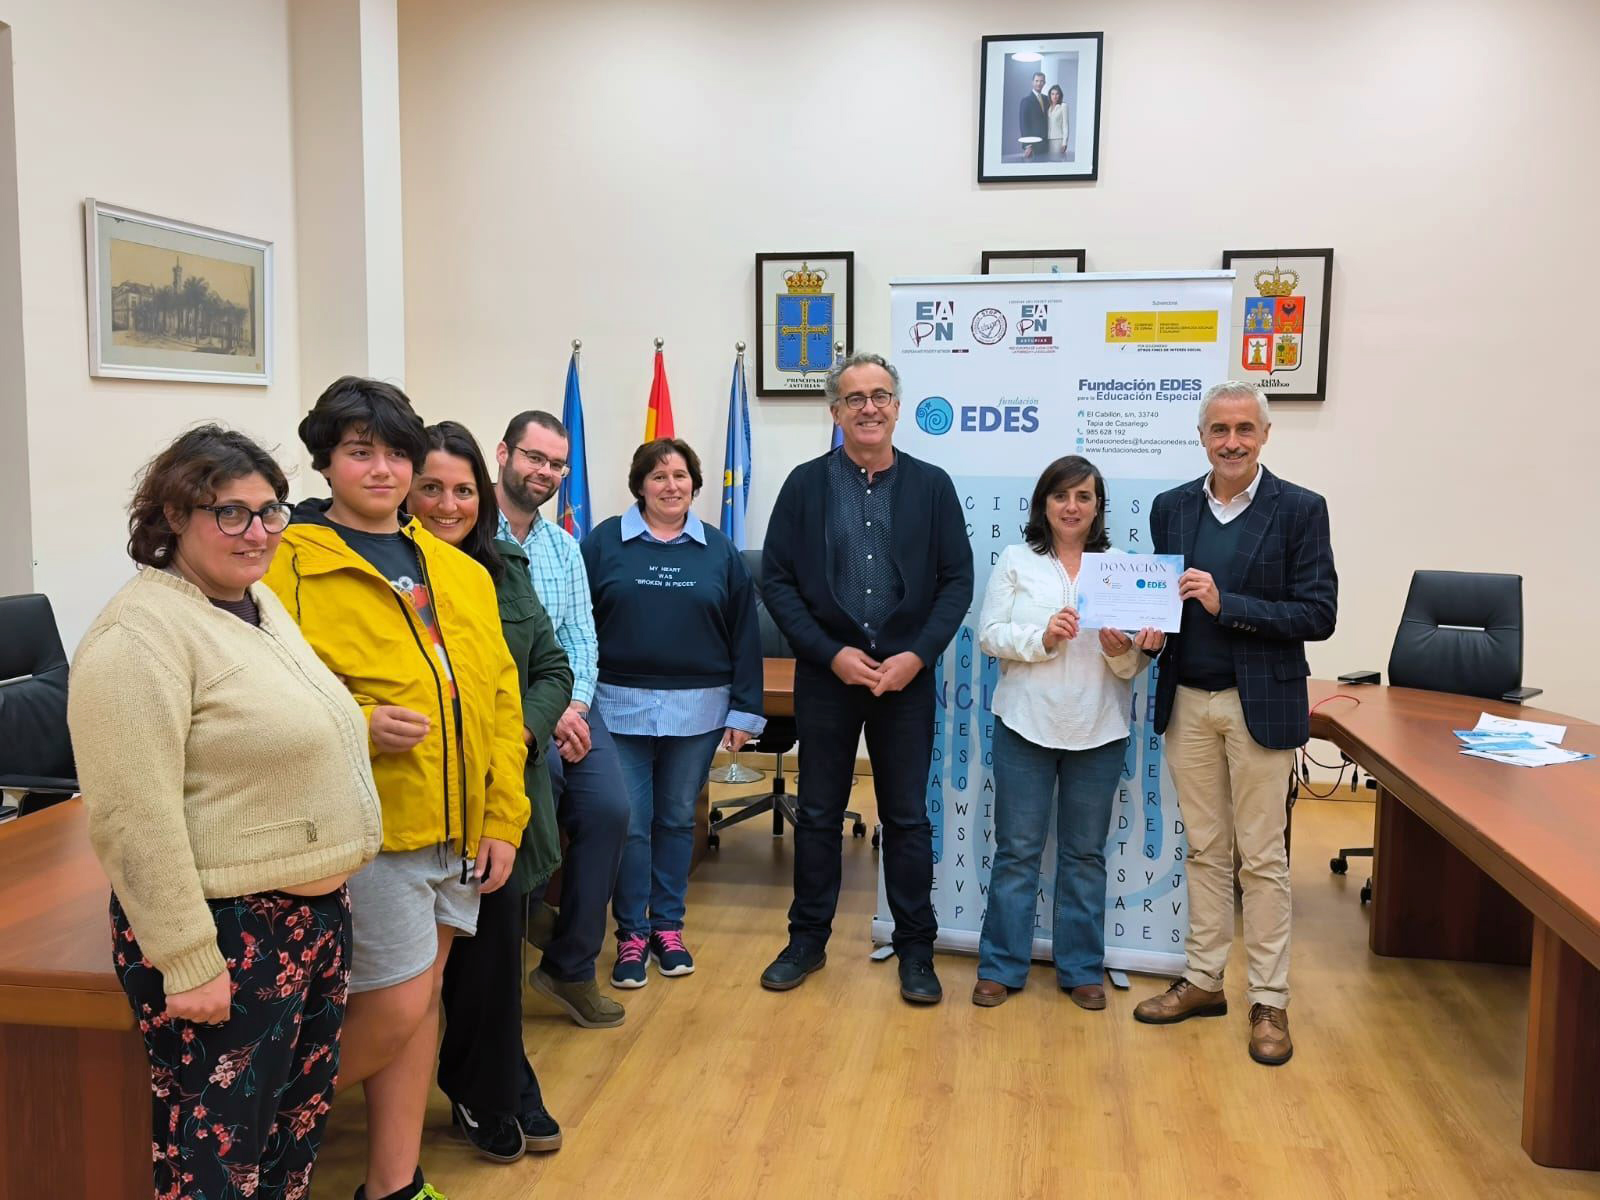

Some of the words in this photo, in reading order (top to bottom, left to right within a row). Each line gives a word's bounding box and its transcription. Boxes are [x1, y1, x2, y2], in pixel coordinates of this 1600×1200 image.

[1078, 379, 1156, 391] Fundación
[1159, 379, 1202, 391] EDES
[997, 394, 1039, 407] fundación
[1096, 391, 1152, 401] Educación
[1155, 391, 1202, 403] Especial
[960, 406, 1039, 433] EDES
[1087, 420, 1104, 428] Tapia
[1115, 420, 1149, 428] Casariego
[965, 496, 975, 510] C
[993, 496, 1000, 511] I
[1019, 497, 1029, 511] D
[1131, 499, 1140, 514] S
[965, 523, 974, 538] C
[992, 524, 1001, 538] B
[1129, 528, 1139, 543] R
[1100, 560, 1167, 572] DONACIÓN
[1147, 581, 1167, 589] EDES
[961, 627, 971, 642] A
[960, 655, 970, 668] C
[988, 656, 997, 670] P
[955, 683, 974, 710] C
[960, 723, 968, 736] E
[986, 725, 993, 738] E
[1149, 736, 1159, 751] B
[932, 748, 941, 761] D
[960, 749, 967, 763] S
[1149, 764, 1157, 778] E
[931, 774, 941, 788] A
[958, 776, 967, 789] O
[984, 778, 994, 792] A
[1120, 789, 1128, 803] E
[1147, 792, 1158, 806] R
[931, 799, 941, 813] D
[955, 802, 968, 816] W
[984, 804, 991, 817] I
[1119, 816, 1128, 830] D
[1146, 818, 1155, 832] E
[1175, 820, 1185, 834] D
[957, 827, 965, 840] S
[983, 829, 992, 843] Y
[1117, 842, 1127, 856] T
[1145, 844, 1155, 858] S
[1174, 847, 1183, 861] S
[956, 853, 965, 868] X
[982, 856, 991, 869] R
[1117, 868, 1126, 882] S
[1145, 871, 1154, 885] Y
[1172, 874, 1182, 888] J
[956, 880, 964, 893] V
[1115, 896, 1126, 910] A
[1144, 899, 1153, 913] R
[1172, 901, 1181, 915] V
[955, 905, 964, 919] P
[1115, 923, 1125, 937] D
[1143, 926, 1152, 940] E
[1171, 929, 1180, 943] S
